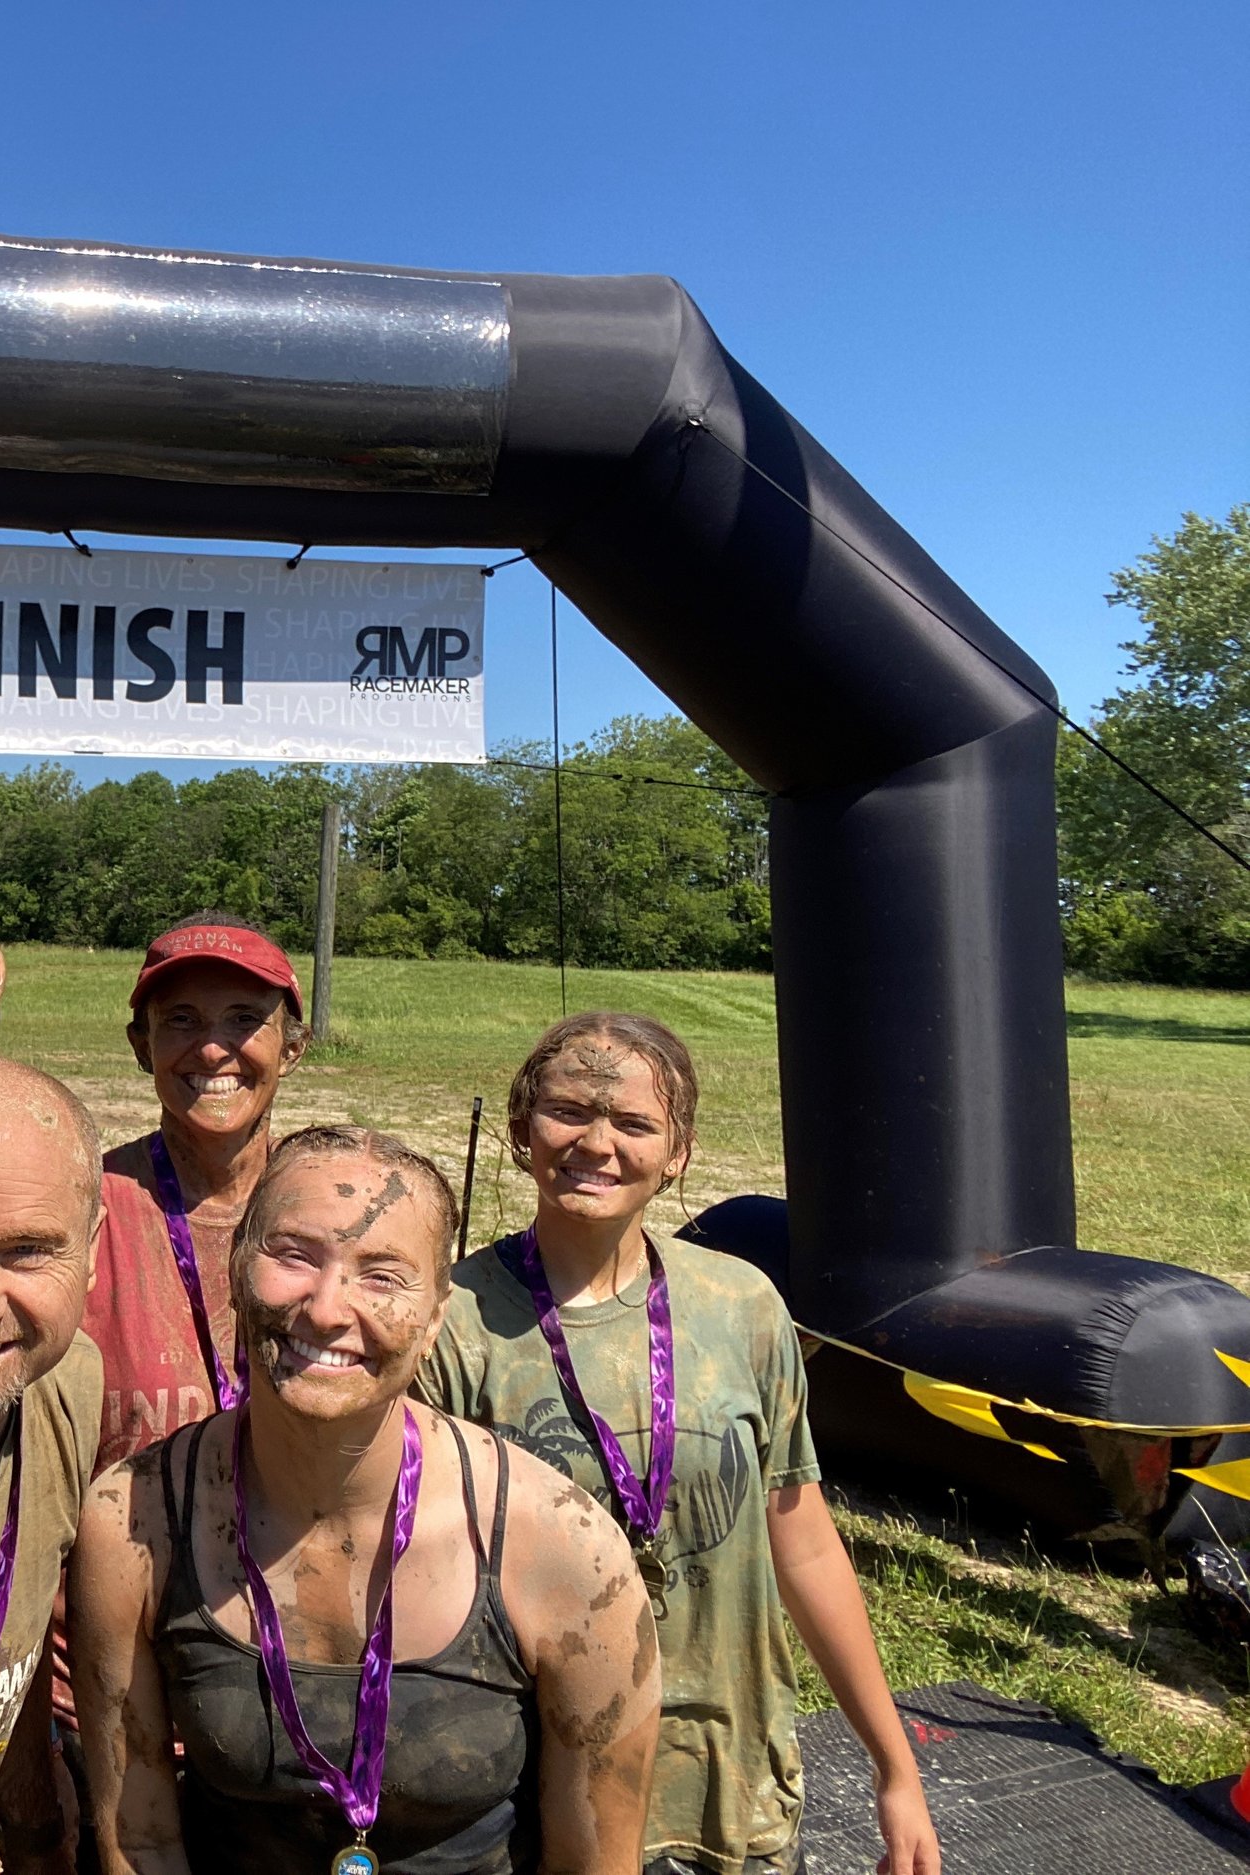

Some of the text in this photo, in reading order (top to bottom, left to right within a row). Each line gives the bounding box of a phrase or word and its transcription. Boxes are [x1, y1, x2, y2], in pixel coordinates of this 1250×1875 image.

[125, 557, 217, 592] LIVES
[235, 562, 390, 599] SHAPING
[402, 569, 485, 602] LIVE
[350, 676, 470, 695] RACEMAKER
[350, 692, 472, 703] PRODUCTIONS
[245, 693, 400, 733] SHAPING
